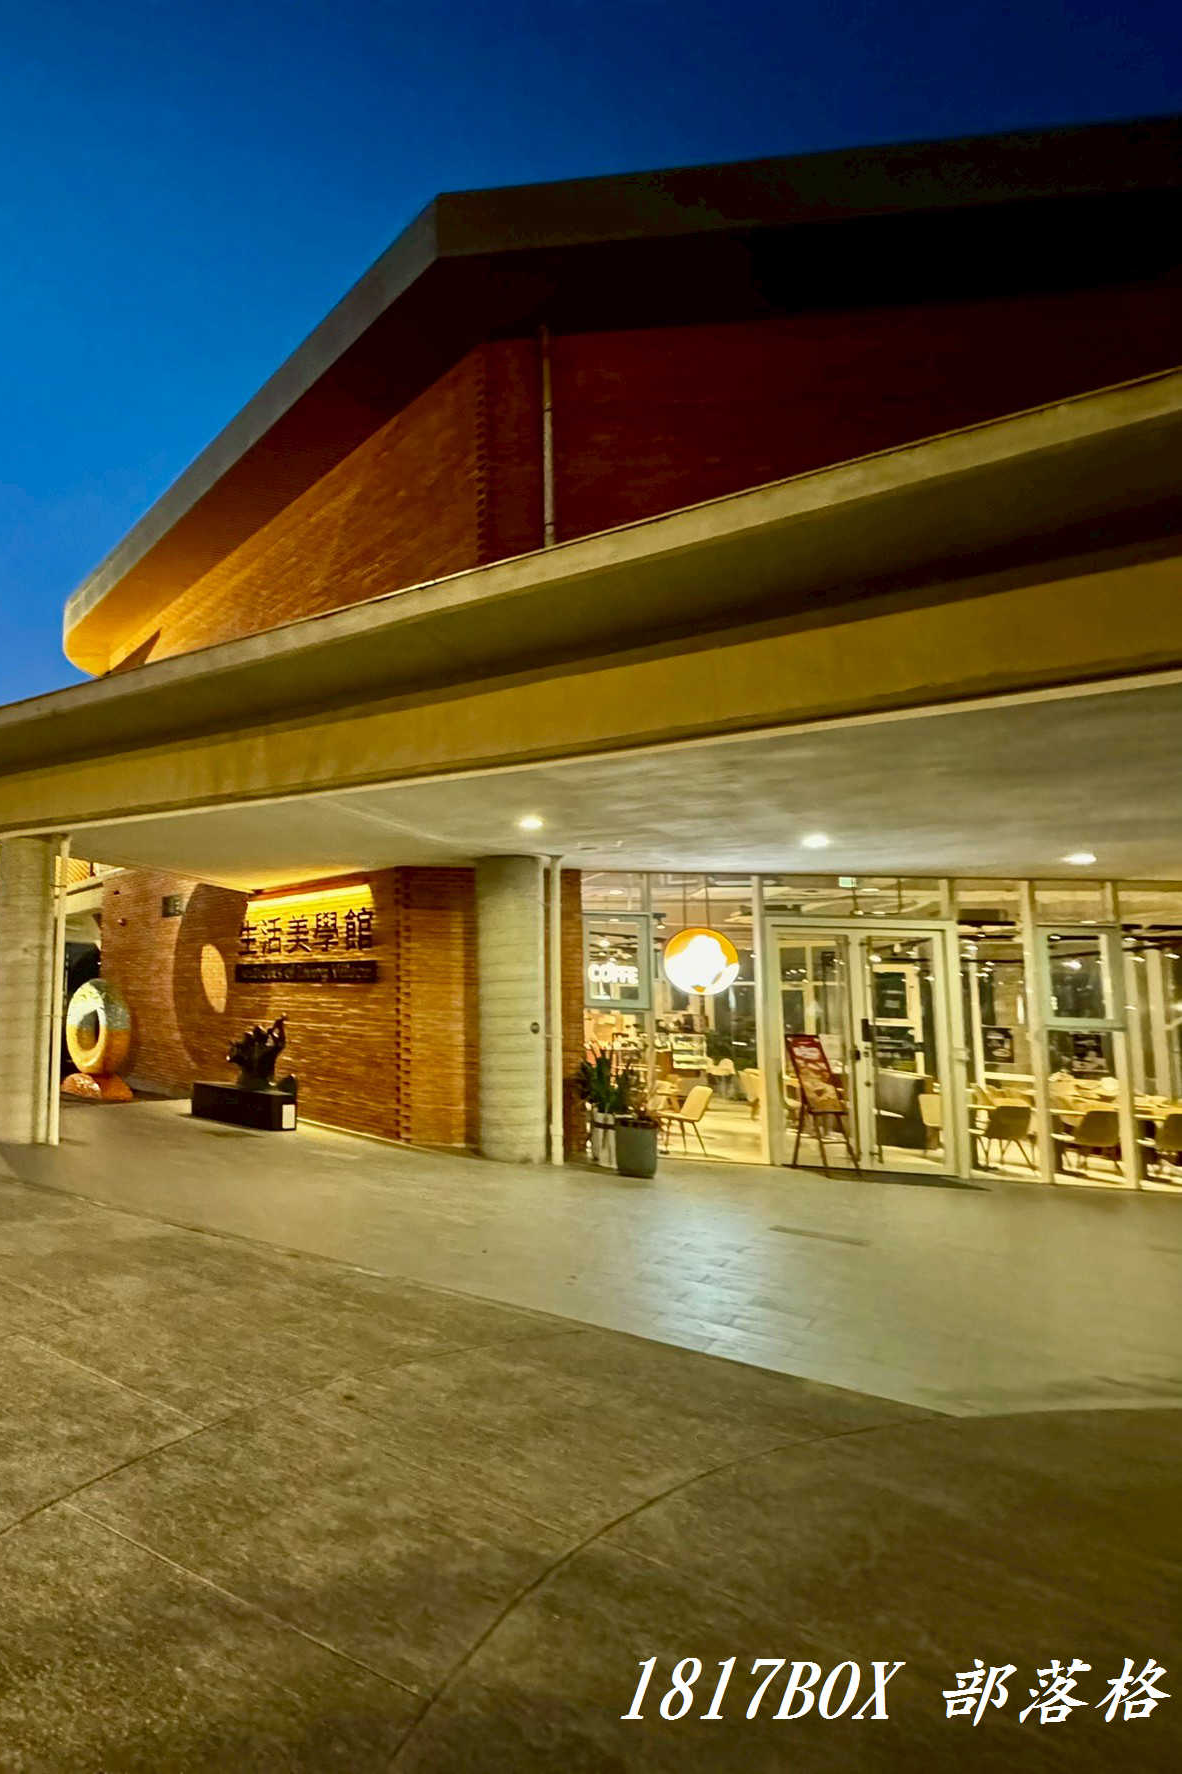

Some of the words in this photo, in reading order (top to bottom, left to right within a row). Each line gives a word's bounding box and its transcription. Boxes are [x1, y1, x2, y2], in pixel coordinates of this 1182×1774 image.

[238, 907, 374, 955] 生活美學館
